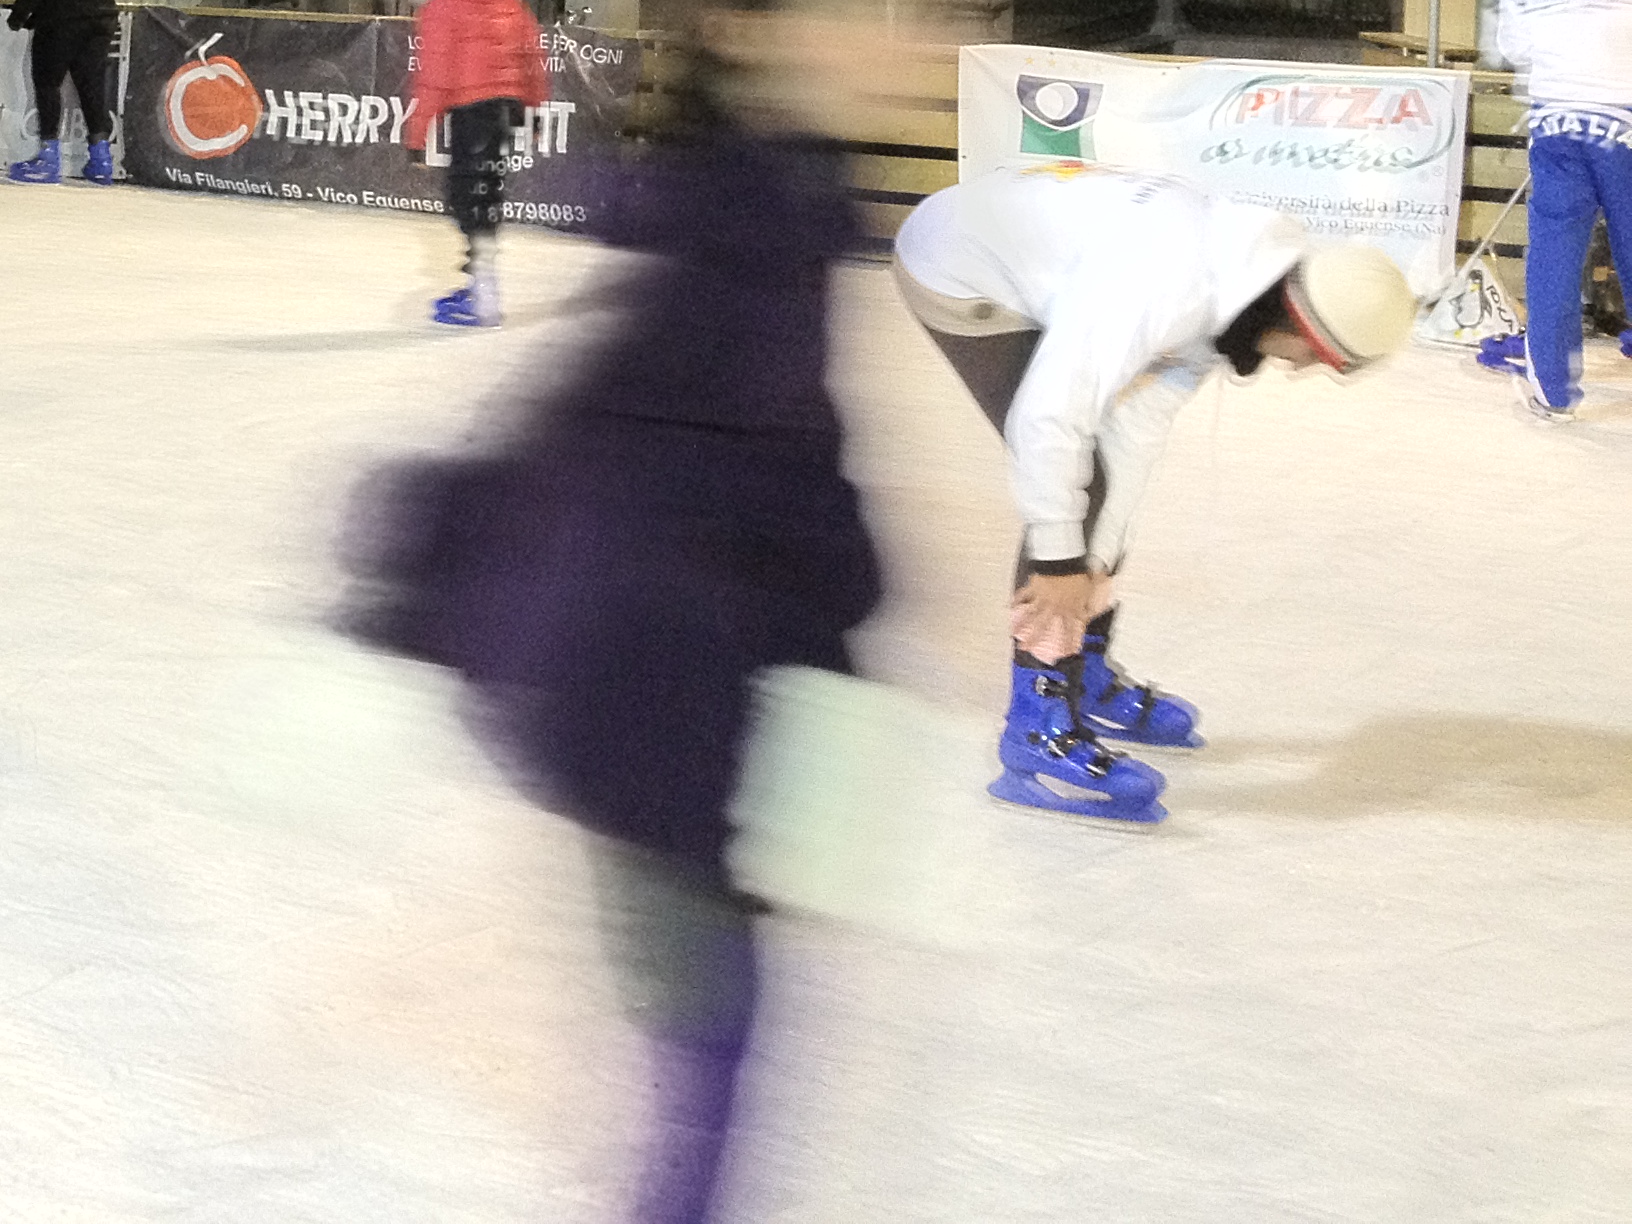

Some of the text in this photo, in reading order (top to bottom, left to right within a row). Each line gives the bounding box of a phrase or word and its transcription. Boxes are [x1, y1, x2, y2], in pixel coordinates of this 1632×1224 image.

[580, 44, 623, 65] OGNI
[1236, 85, 1435, 127] PIZZA
[165, 167, 193, 185] Via
[281, 183, 303, 199] 59
[317, 187, 359, 205] Vico
[1236, 190, 1450, 217] iversità della Pizza
